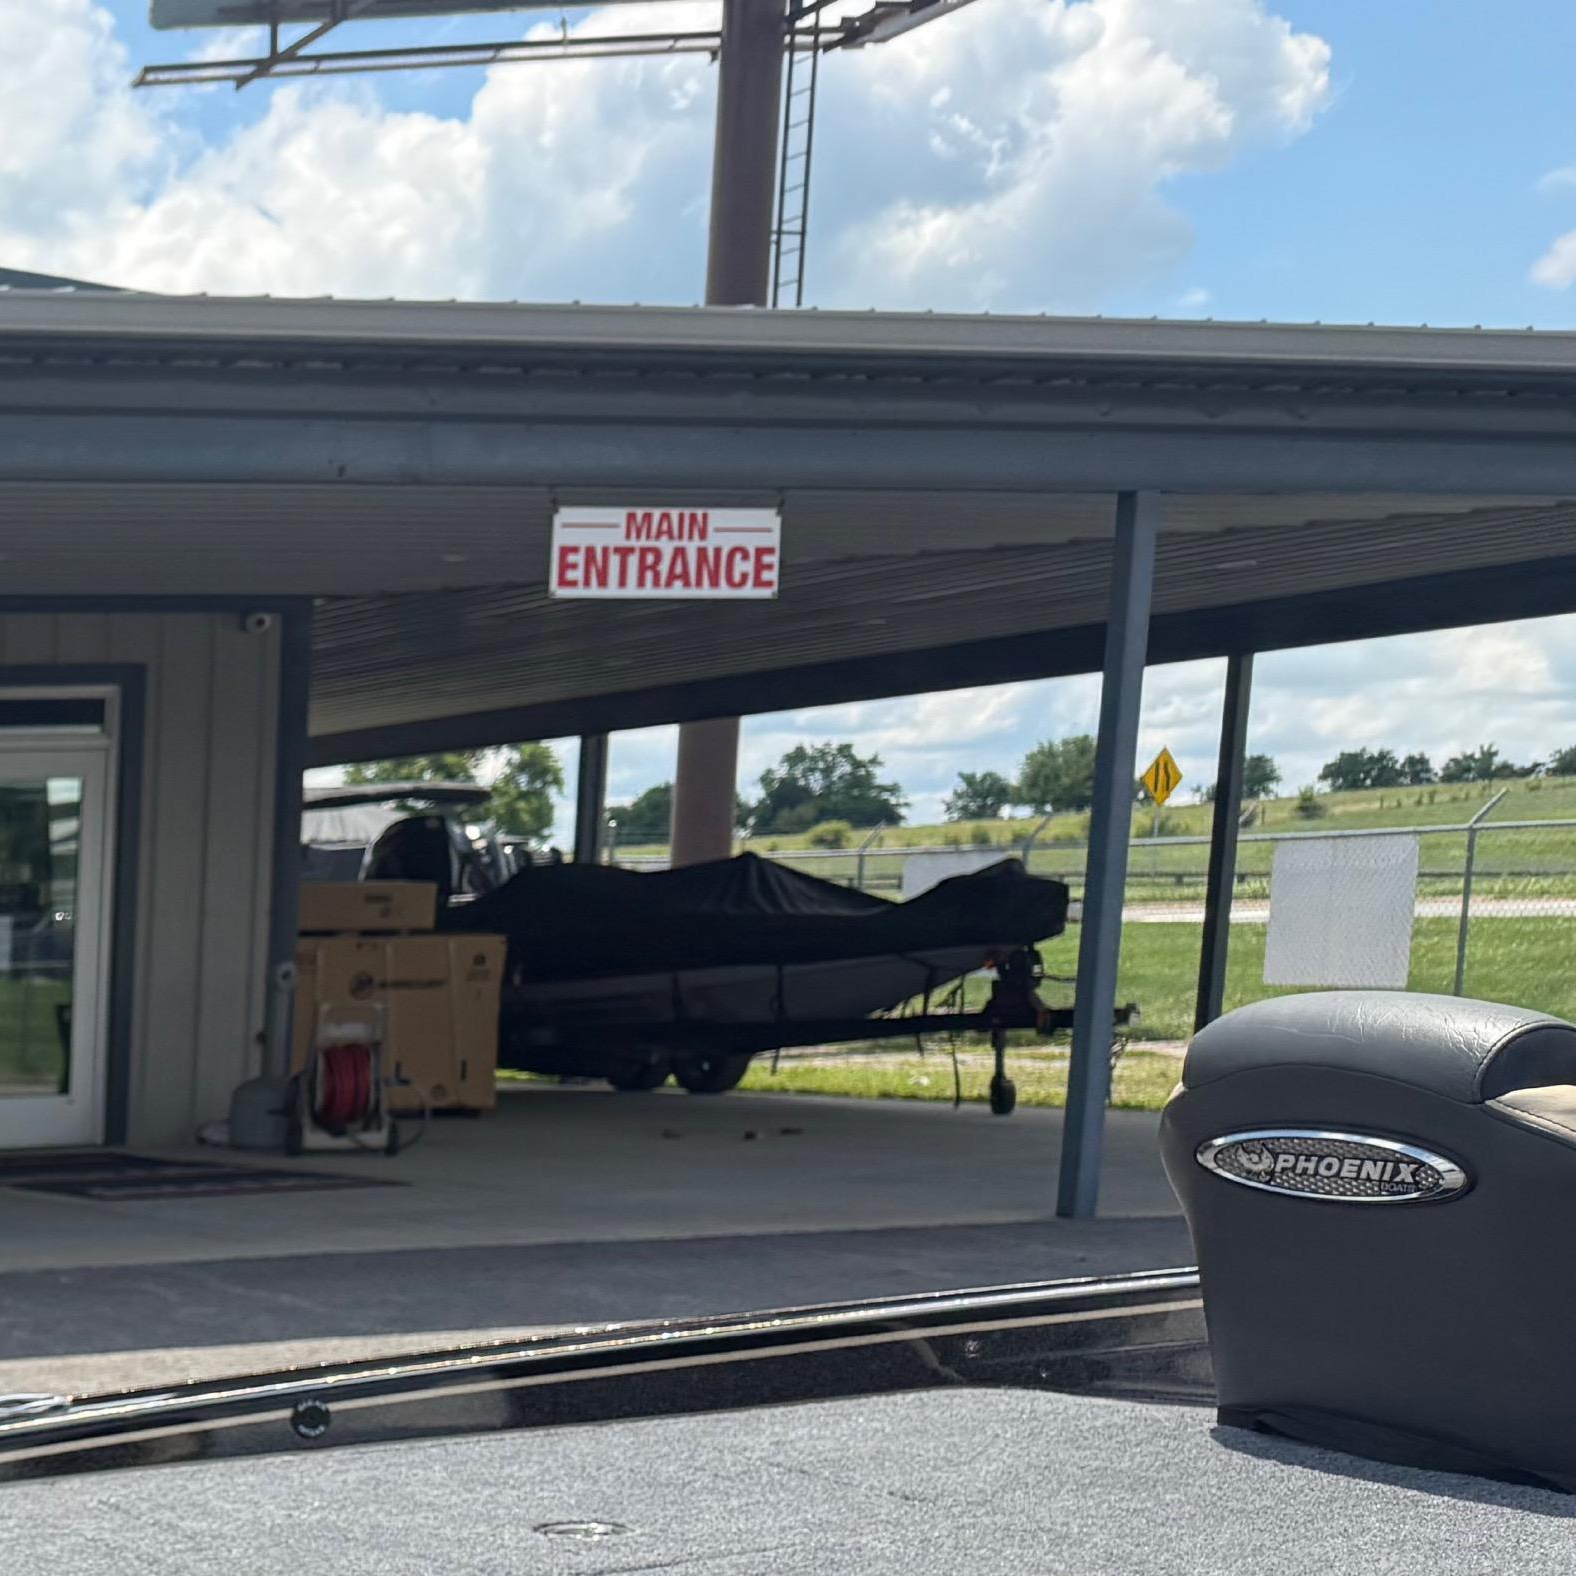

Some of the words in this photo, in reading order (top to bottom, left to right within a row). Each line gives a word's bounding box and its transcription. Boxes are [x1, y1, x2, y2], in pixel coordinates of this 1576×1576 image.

[624, 511, 709, 541] MAIN
[556, 545, 776, 589] ENTRANCE
[1274, 1153, 1419, 1183] PHOENIX
